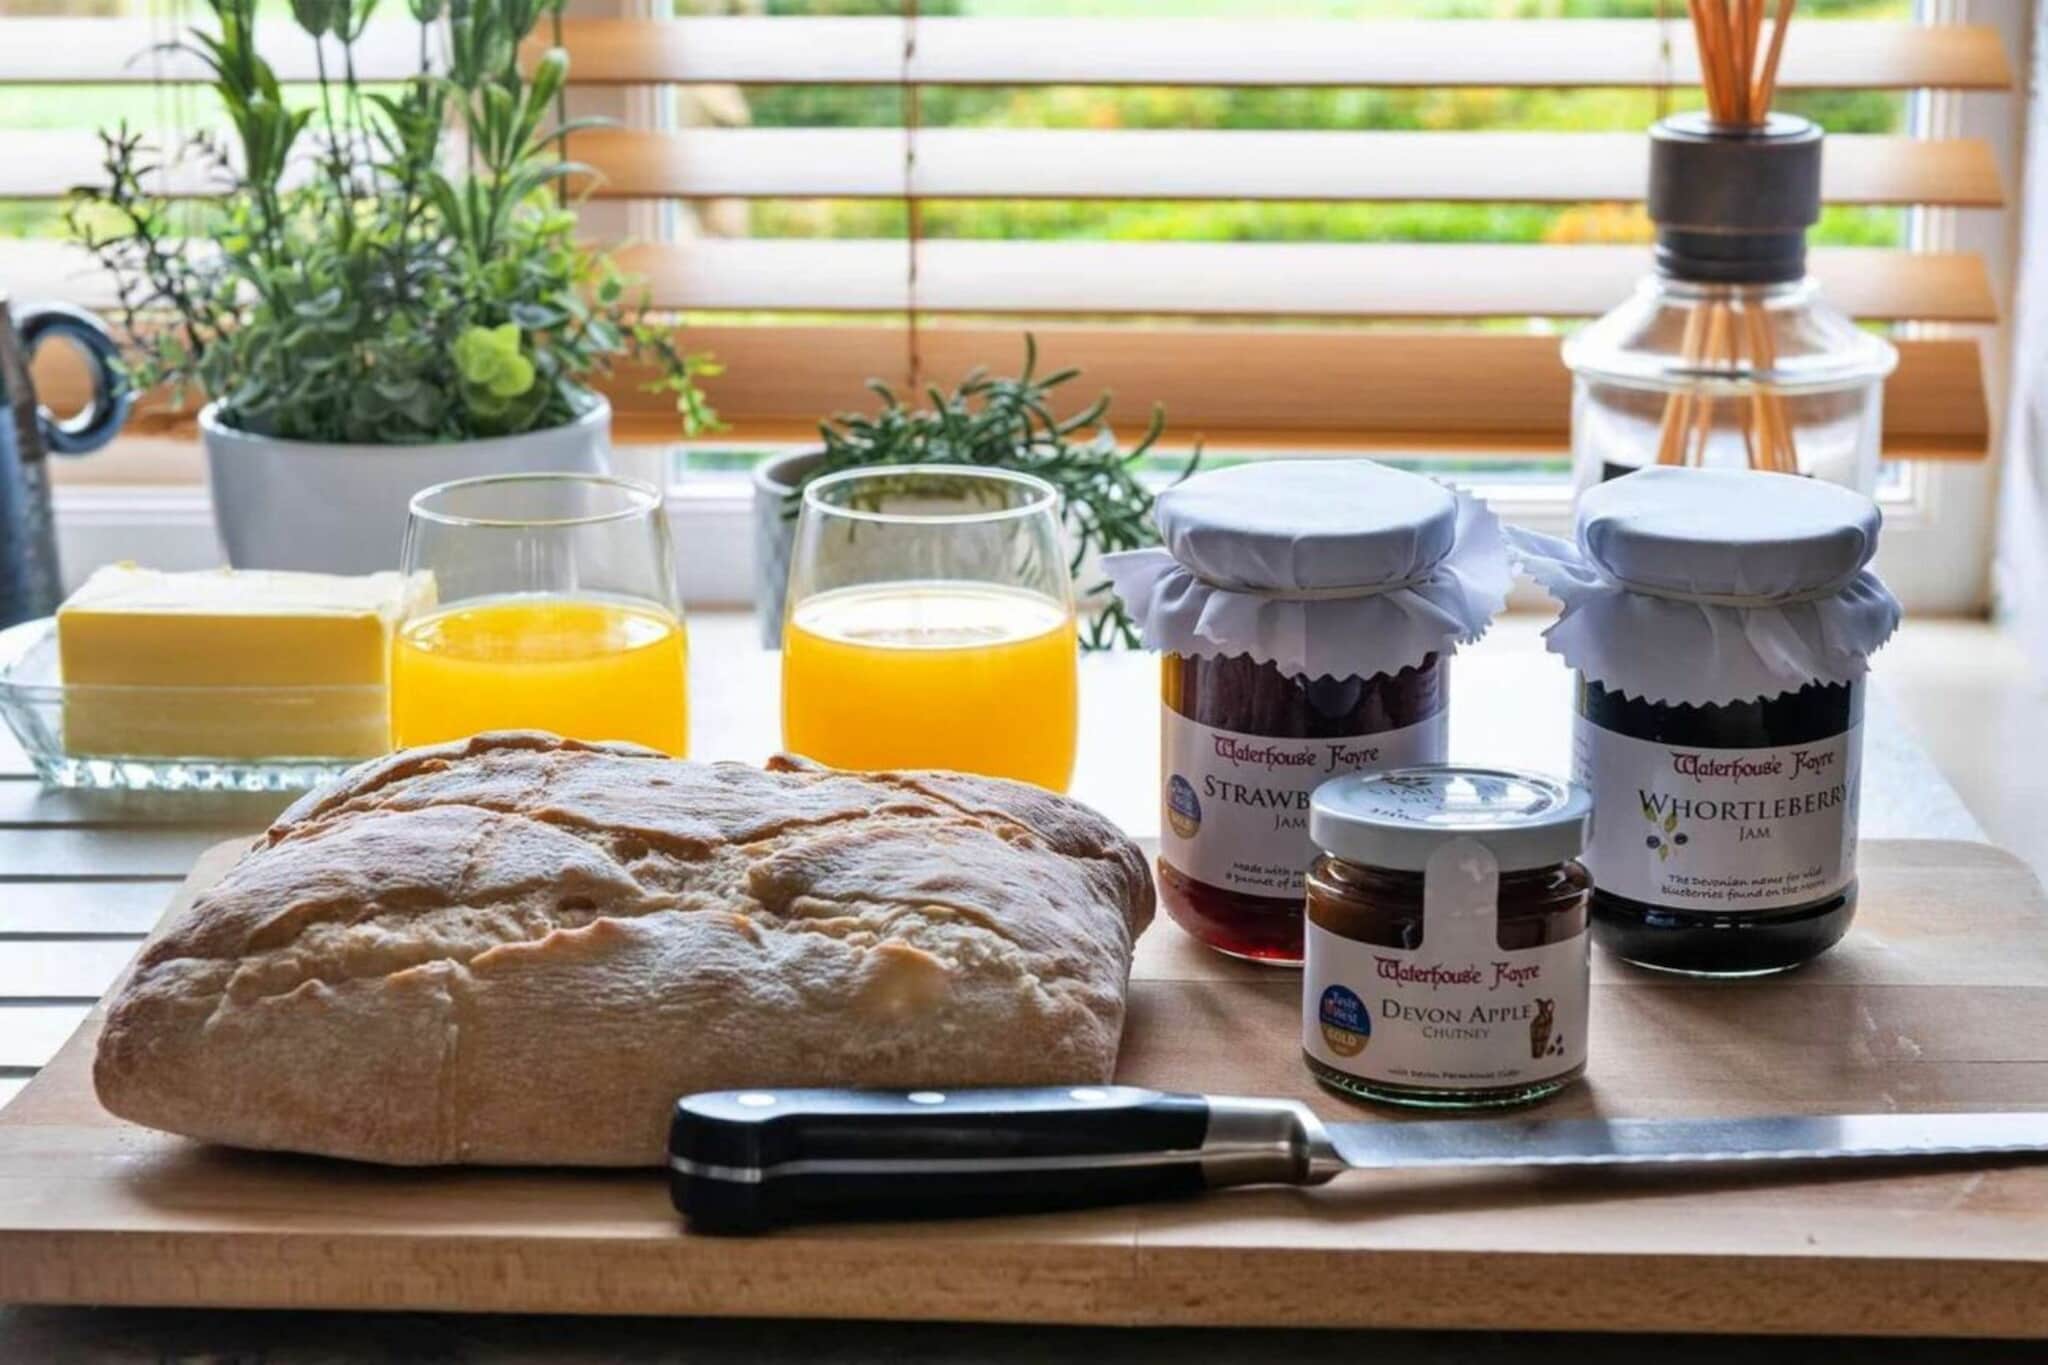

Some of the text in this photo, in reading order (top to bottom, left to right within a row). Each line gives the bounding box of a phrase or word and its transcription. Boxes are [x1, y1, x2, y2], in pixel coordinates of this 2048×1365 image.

[1325, 745, 1379, 773] Fayre
[1789, 751, 1835, 780] Fayre
[1204, 775, 1310, 810] STRAWB
[1274, 815, 1307, 831] JAM
[1738, 826, 1770, 842] JAM
[1264, 864, 1290, 876] with
[1751, 876, 1783, 886] name
[1786, 872, 1800, 885] for
[1803, 865, 1823, 878] wild
[1276, 877, 1290, 892] of
[1661, 884, 1724, 899] blueberries
[1727, 886, 1763, 901] found
[1765, 888, 1779, 897] on
[1783, 886, 1798, 895] the
[1489, 960, 1540, 991] Fayre
[1382, 999, 1531, 1024] DEVON APPLE
[1422, 1025, 1491, 1040] CHUTNEY
